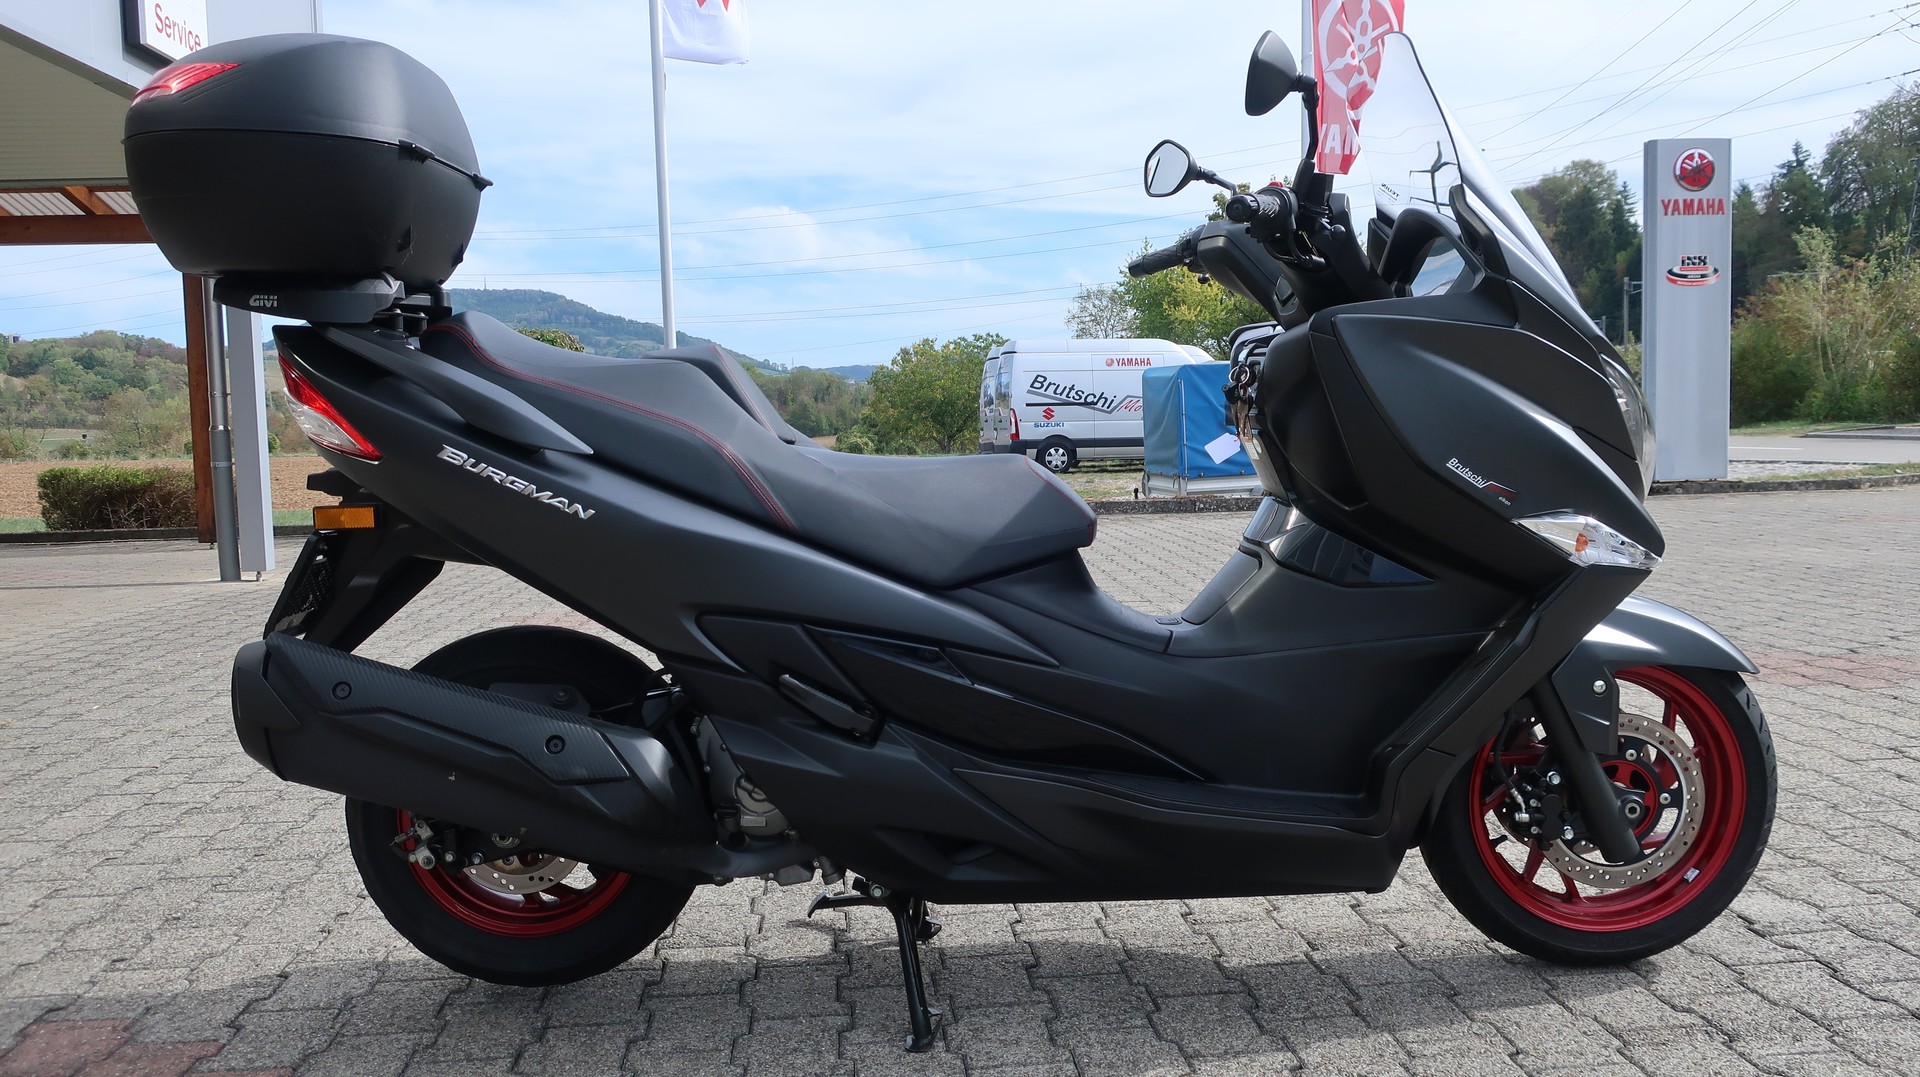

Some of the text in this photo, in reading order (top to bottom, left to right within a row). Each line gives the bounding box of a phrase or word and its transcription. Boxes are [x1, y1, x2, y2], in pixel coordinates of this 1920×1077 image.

[154, 3, 201, 52] Service
[1661, 198, 1726, 216] YAMAHA
[1115, 357, 1152, 367] YAMAHA
[1029, 373, 1117, 410] Brutschi
[1033, 421, 1065, 429] SUZUKI
[437, 443, 596, 520] BURGMAN
[1447, 457, 1487, 486] Brutschi
